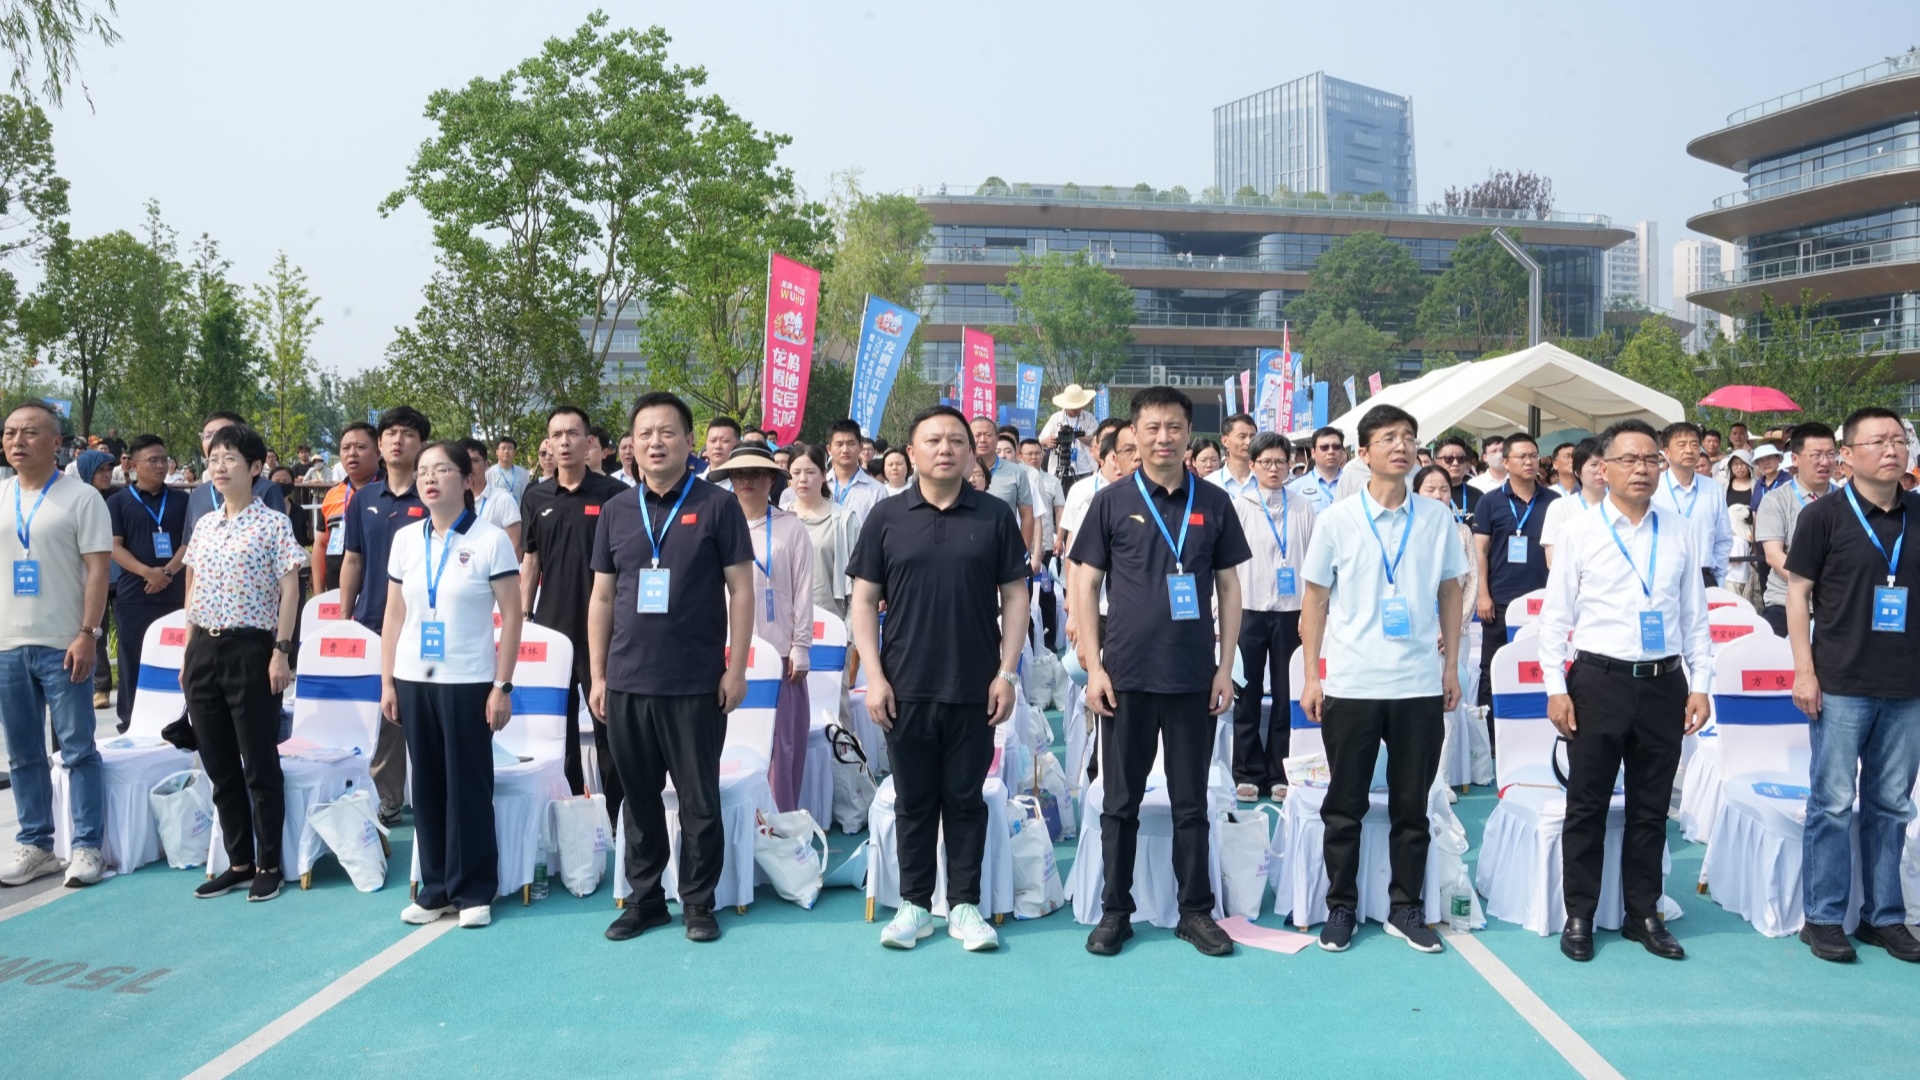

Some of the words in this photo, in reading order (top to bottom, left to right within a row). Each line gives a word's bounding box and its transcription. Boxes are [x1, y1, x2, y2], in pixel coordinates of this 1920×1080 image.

[780, 288, 805, 306] WUHU
[870, 340, 897, 392] 龙腾皖江
